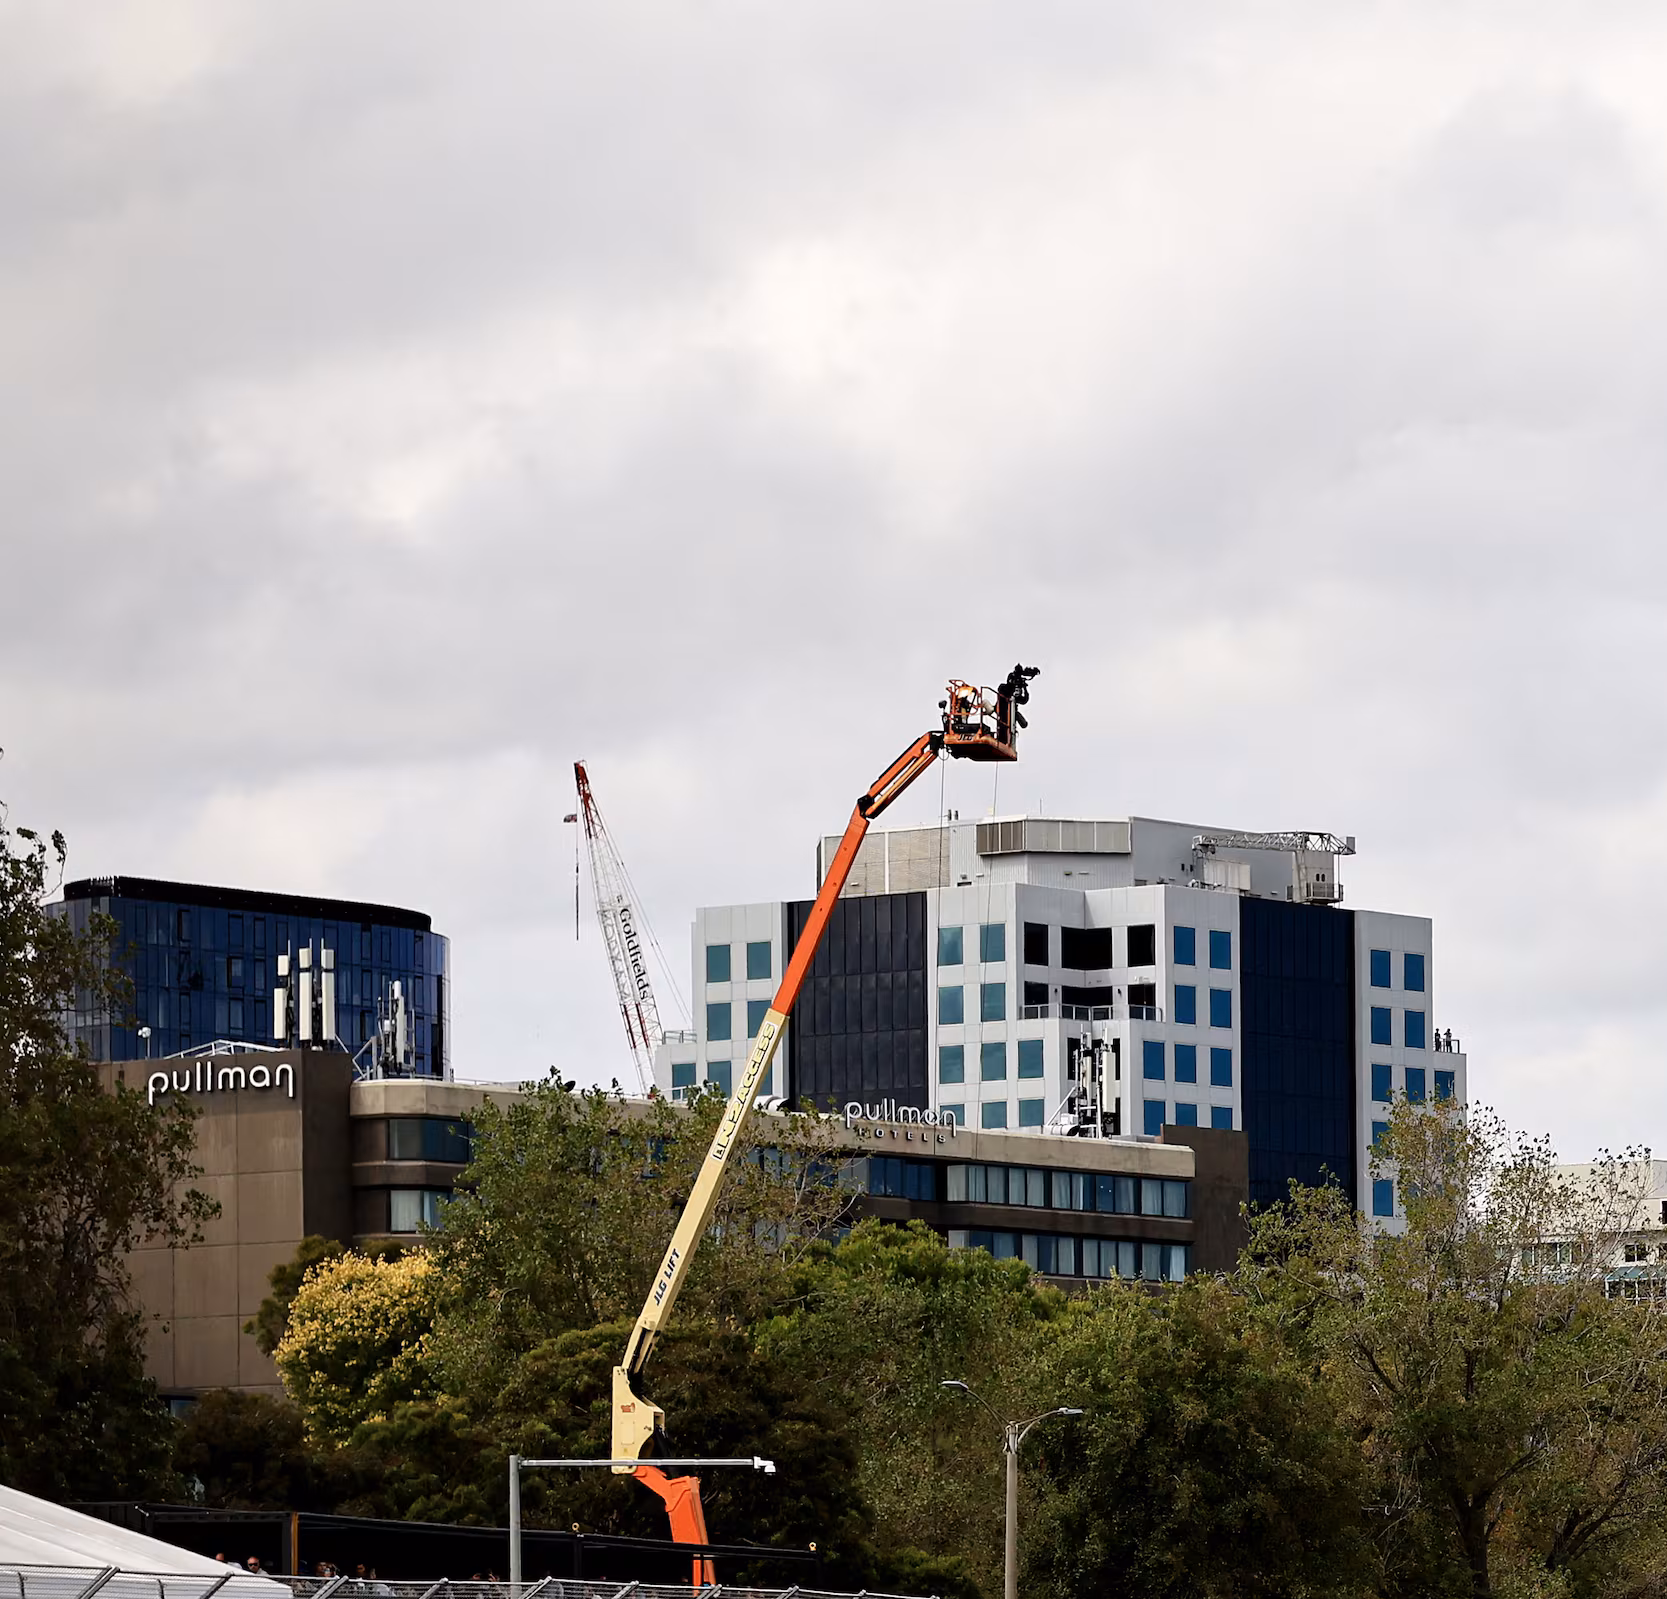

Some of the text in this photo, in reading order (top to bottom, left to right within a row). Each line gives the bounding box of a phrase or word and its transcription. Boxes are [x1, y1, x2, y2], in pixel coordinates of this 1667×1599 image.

[619, 908, 650, 1001] Goldfields
[148, 1061, 294, 1106] pullman
[846, 1098, 957, 1138] pullman
[859, 1127, 946, 1143] HOTELS
[654, 1248, 680, 1306] JLG LIFT
